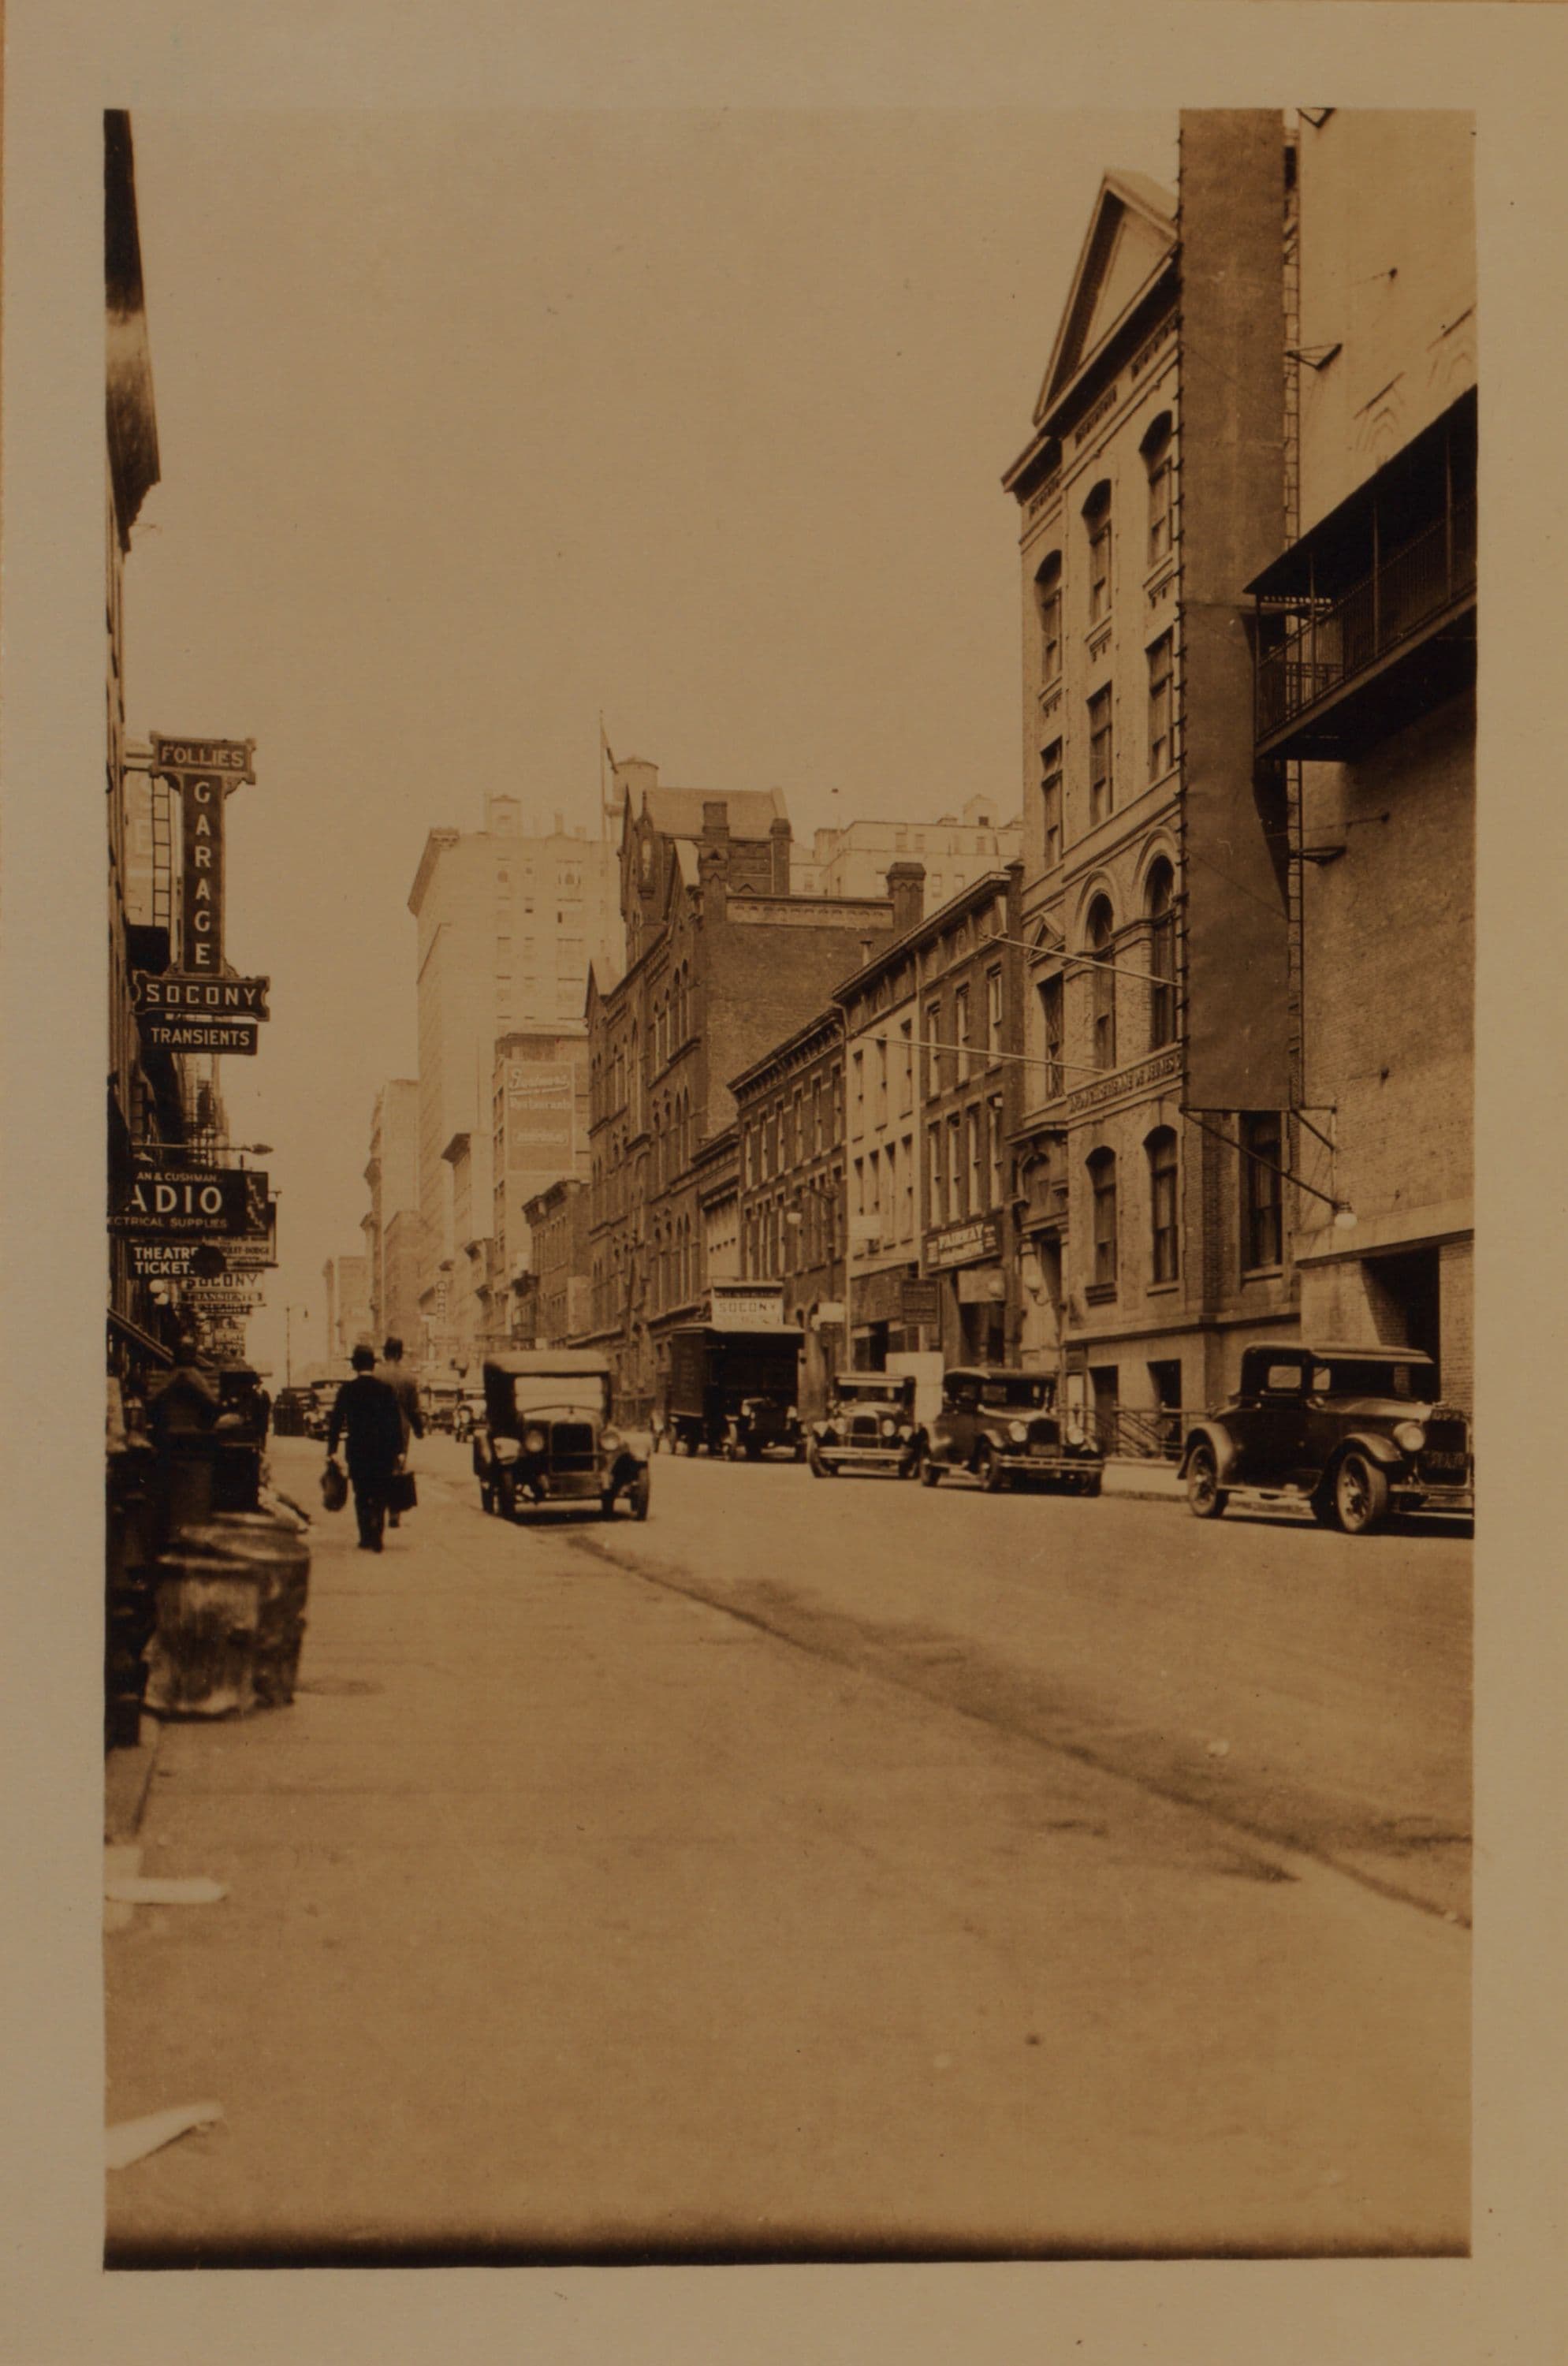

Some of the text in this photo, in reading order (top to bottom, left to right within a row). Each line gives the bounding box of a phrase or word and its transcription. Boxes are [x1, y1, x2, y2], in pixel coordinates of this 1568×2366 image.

[161, 746, 244, 768] FOLLIES
[194, 781, 211, 965] GARAGE
[146, 985, 257, 1005] SOCONY
[151, 1027, 250, 1045] TRANSIENTS
[164, 1172, 217, 1183] CUSHMAN
[125, 1184, 223, 1215] ADIO
[169, 1217, 228, 1229] SUPPLIES
[134, 1261, 196, 1275] TICKET
[718, 1302, 776, 1313] SOCONY
